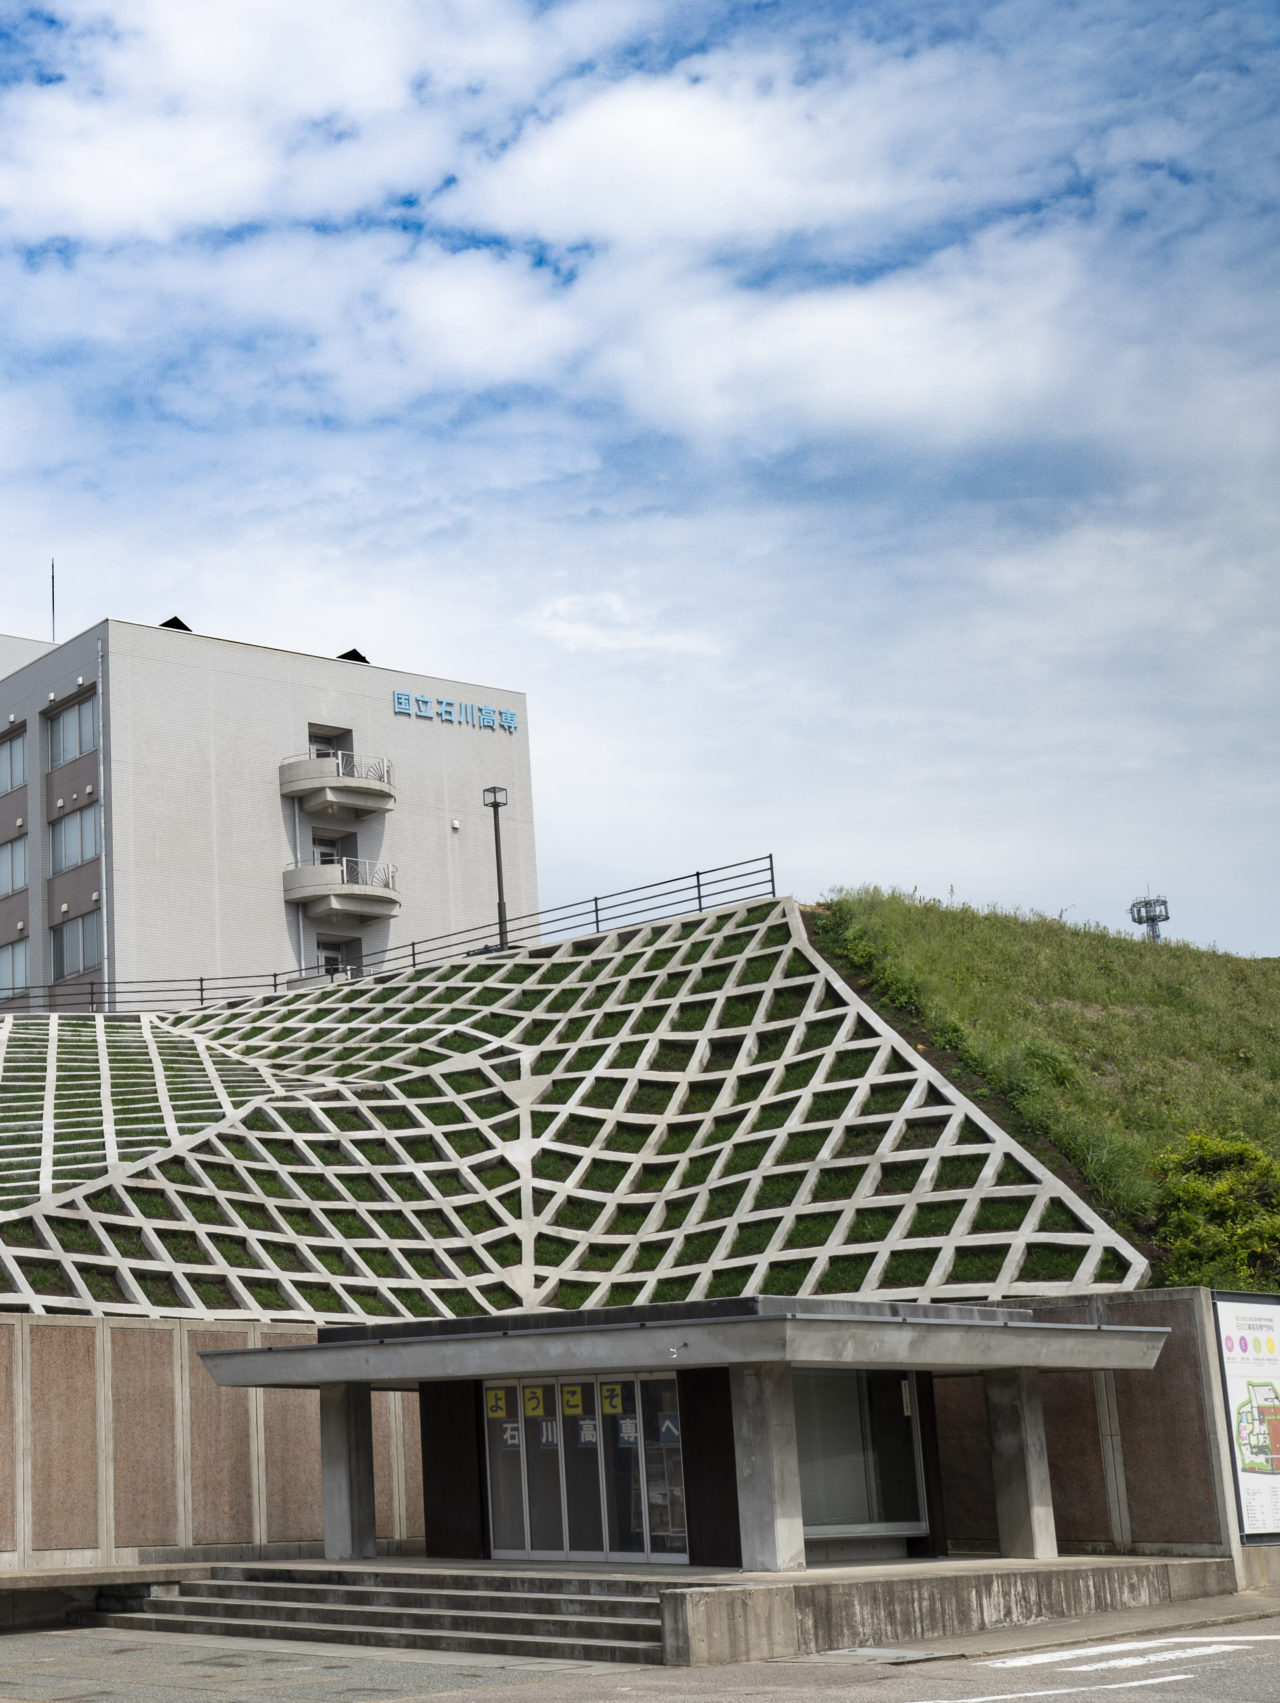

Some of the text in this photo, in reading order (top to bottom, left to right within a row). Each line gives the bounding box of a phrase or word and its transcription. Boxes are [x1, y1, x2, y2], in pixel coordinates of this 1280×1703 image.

[393, 690, 518, 732] 国立石川高専
[489, 1388, 619, 1413] ようこそ
[503, 1419, 680, 1444] 石川高専へ
